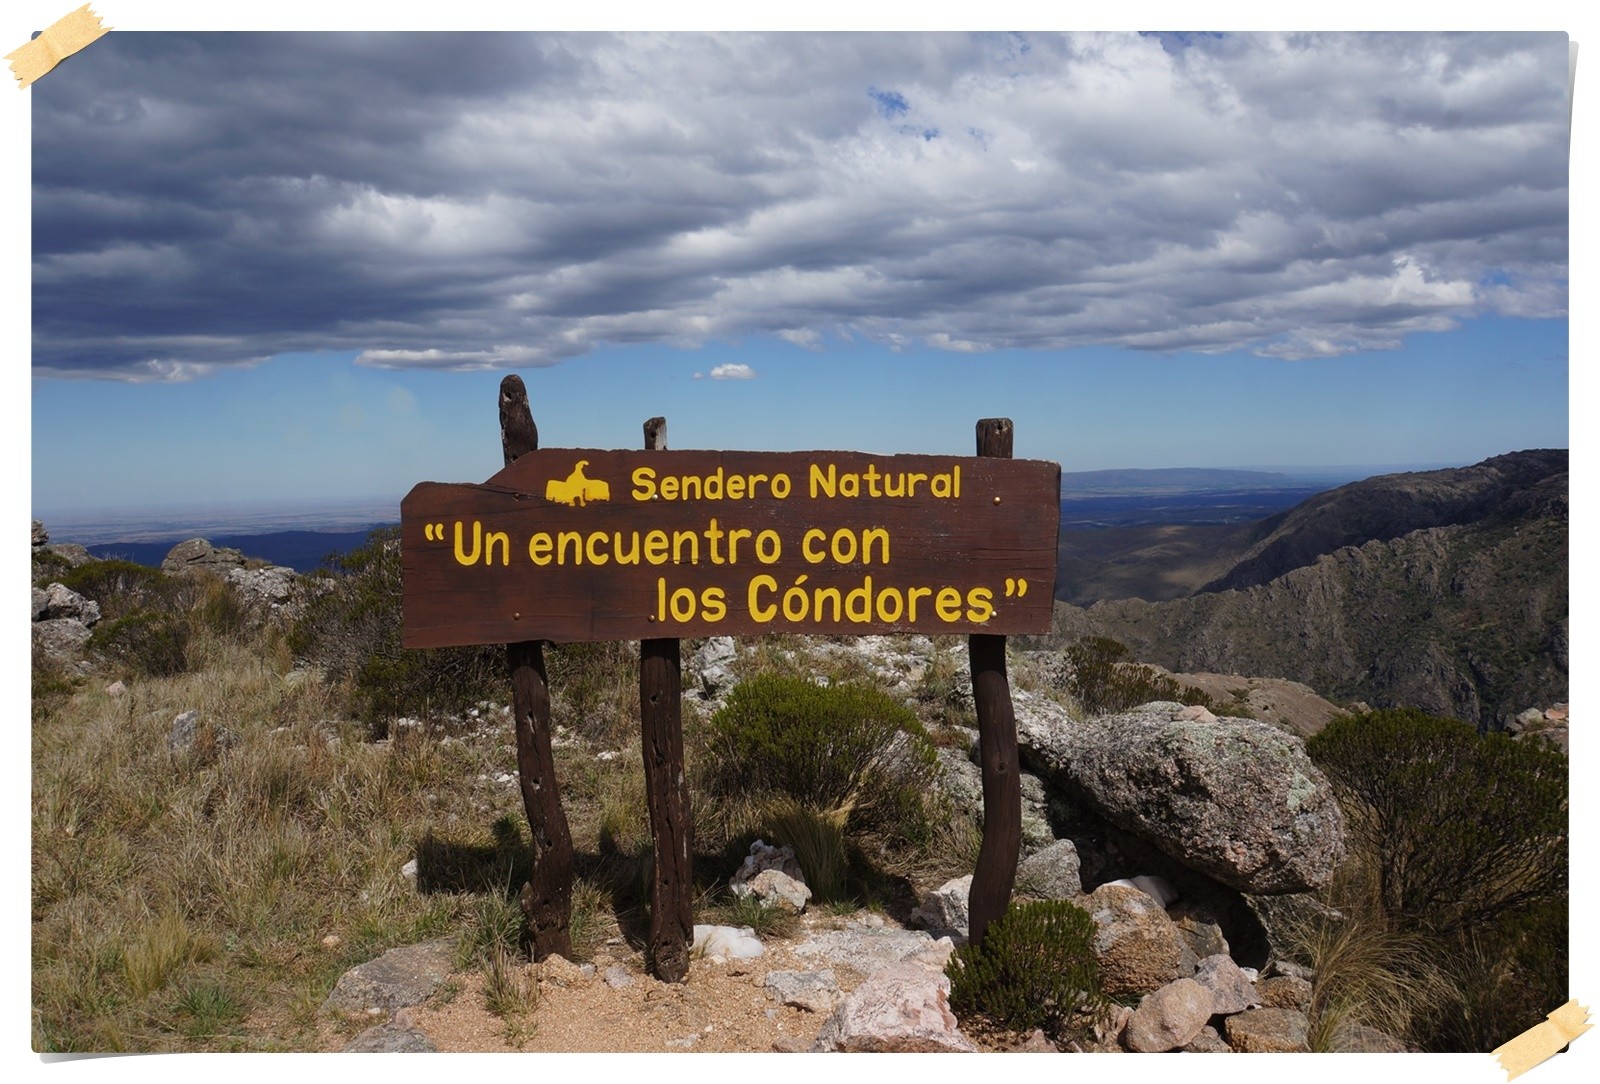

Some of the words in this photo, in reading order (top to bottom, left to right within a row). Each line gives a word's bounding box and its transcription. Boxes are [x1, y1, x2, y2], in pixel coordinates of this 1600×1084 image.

[631, 466, 792, 501] Sendero
[809, 463, 962, 498] Natural
[528, 518, 782, 567] encuentro
[801, 527, 890, 565] con
[657, 576, 727, 623] los
